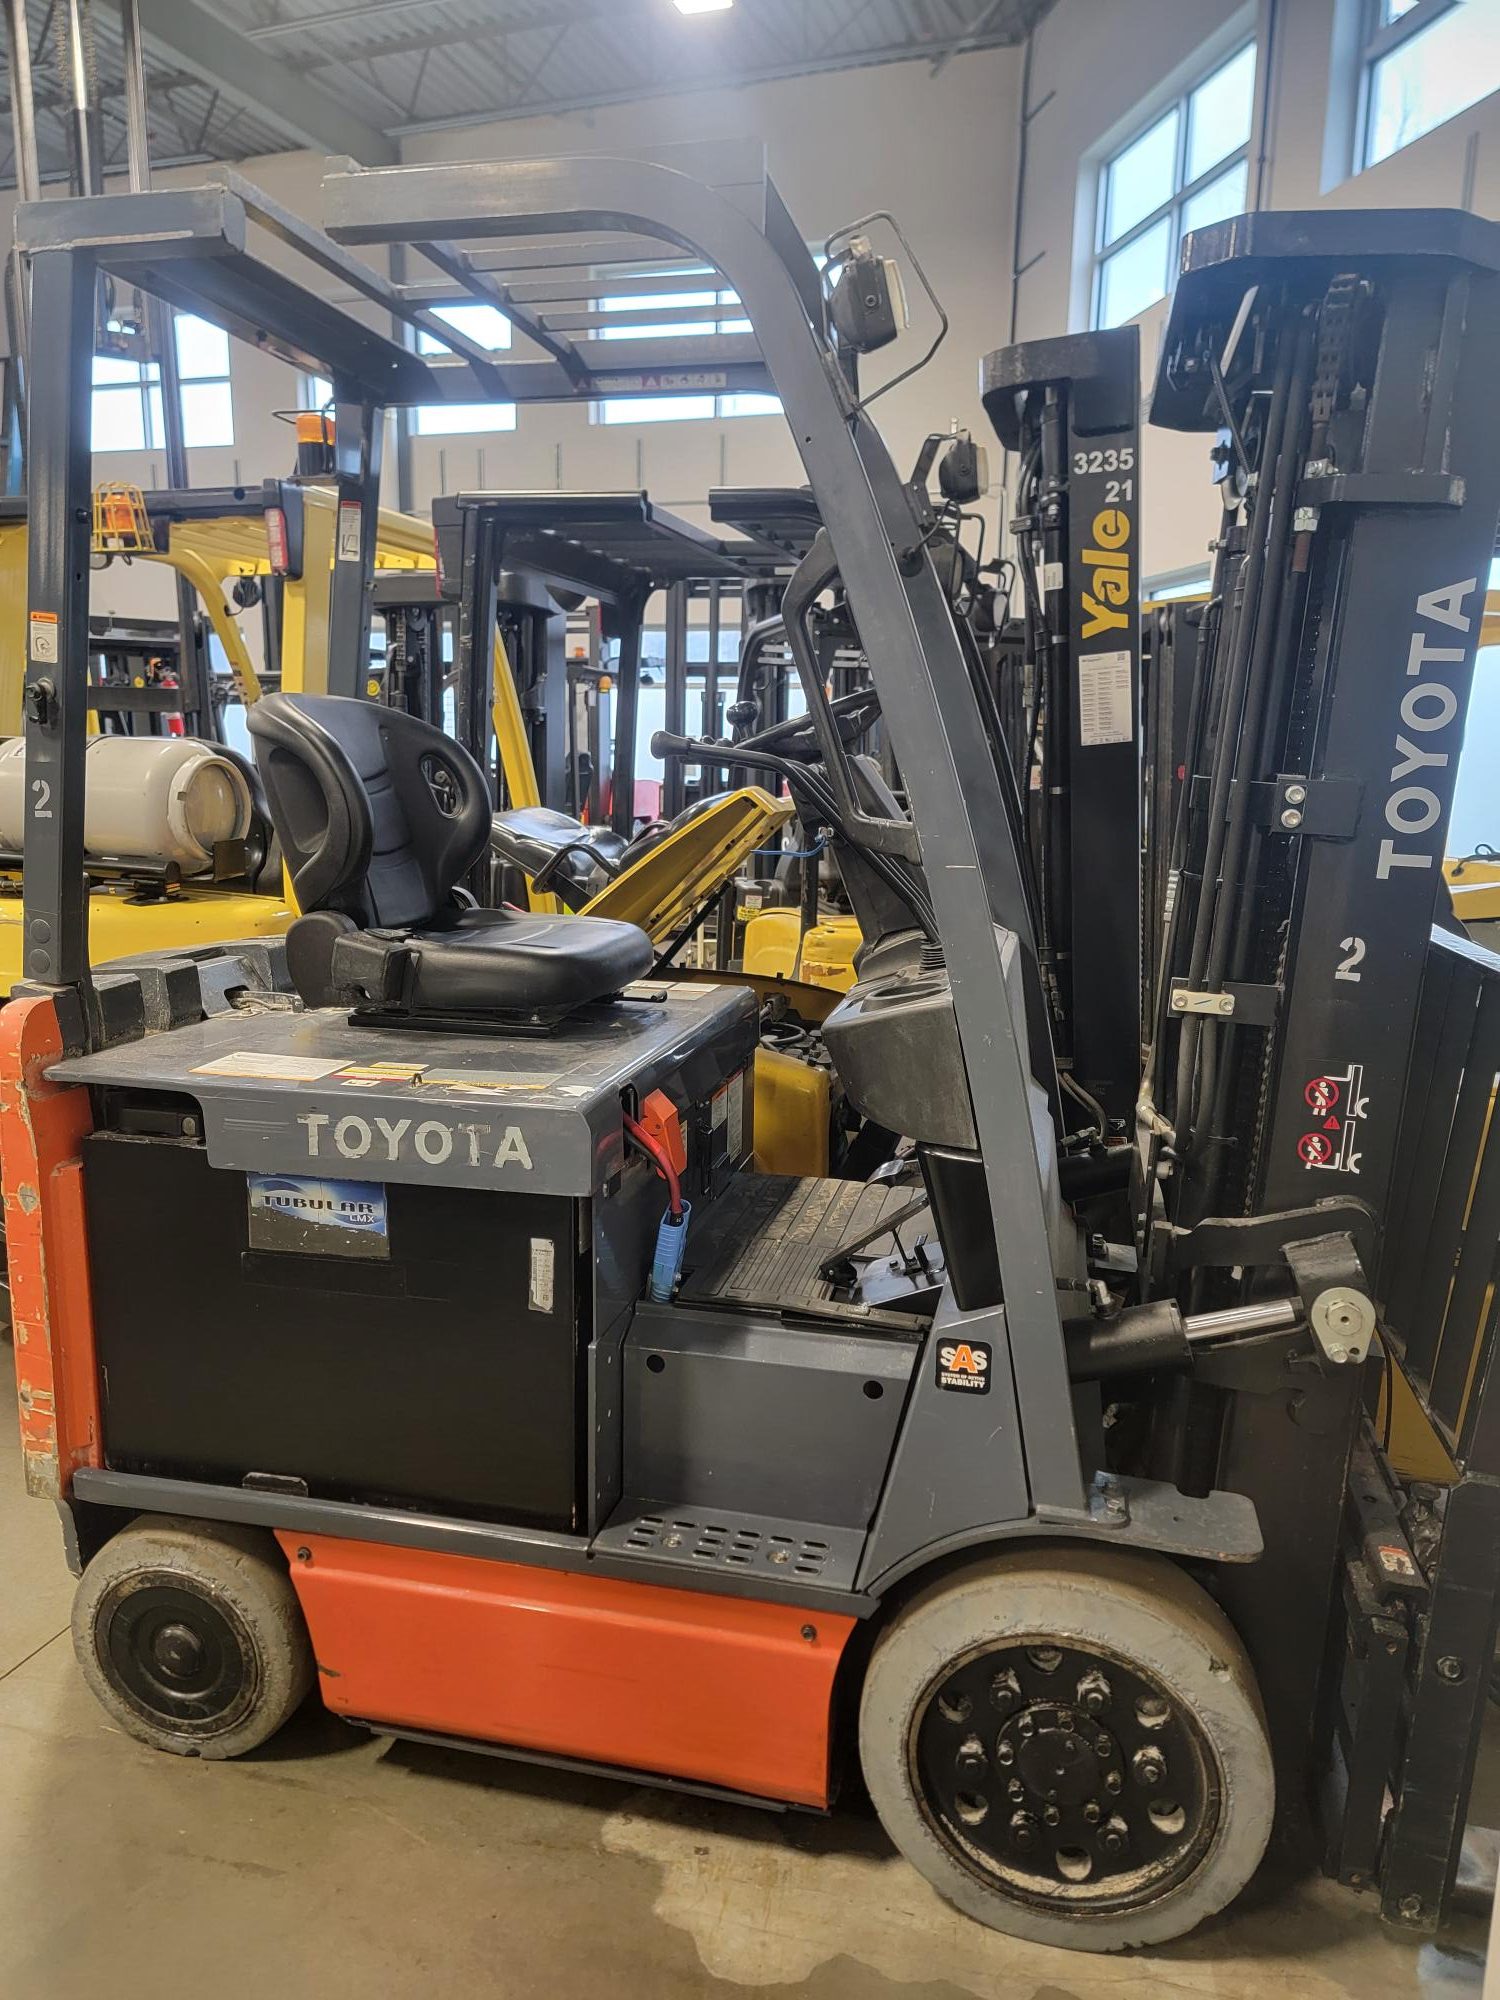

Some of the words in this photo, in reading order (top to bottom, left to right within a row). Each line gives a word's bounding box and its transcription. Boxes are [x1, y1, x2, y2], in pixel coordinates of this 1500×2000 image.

[1073, 448, 1134, 475] 3235
[1105, 479, 1133, 503] 21
[1081, 509, 1131, 640] Yale
[1375, 577, 1477, 880] TOYOTA
[32, 779, 53, 818] 2
[1335, 936, 1366, 982] 2
[297, 1114, 533, 1170] TOYOTA
[262, 1195, 373, 1213] TUBULAR
[349, 1214, 375, 1223] LMX
[940, 1344, 988, 1374] SAS
[941, 1377, 986, 1388] STABILITY
